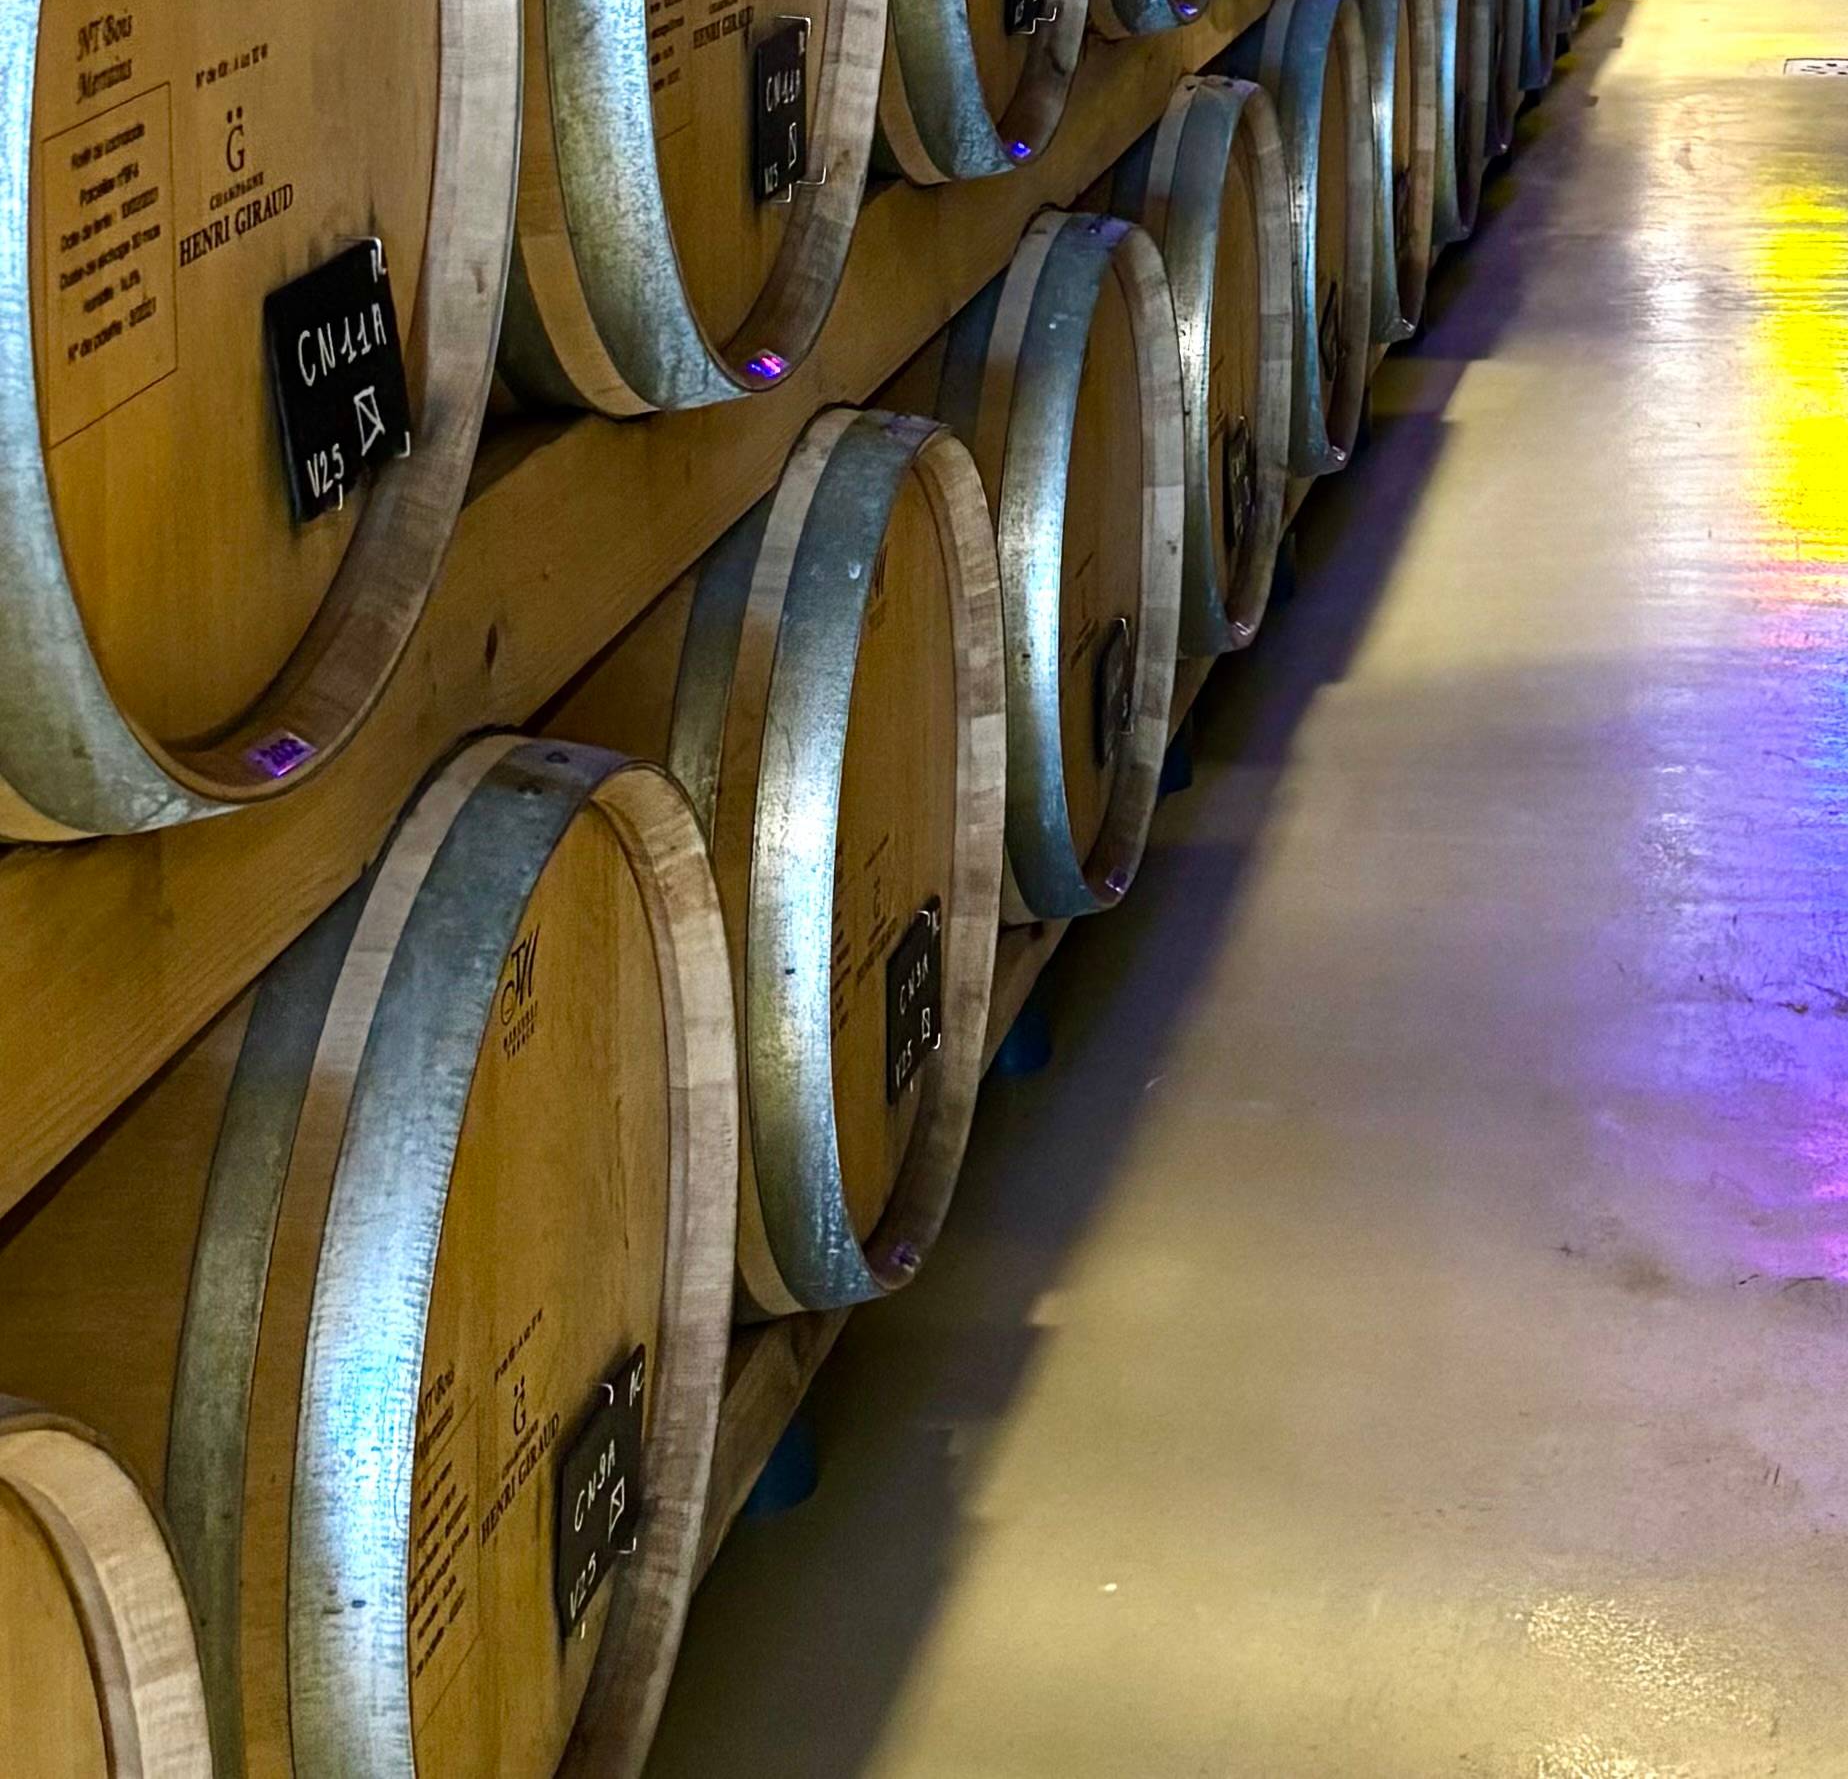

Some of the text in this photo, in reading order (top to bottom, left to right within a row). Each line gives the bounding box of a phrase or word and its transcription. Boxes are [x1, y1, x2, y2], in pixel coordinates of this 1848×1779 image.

[179, 184, 293, 268] HENRI GIRAUD
[298, 302, 387, 387] CN11A
[307, 442, 345, 499] V25
[481, 1474, 517, 1548] HENRI
[518, 1411, 561, 1487] GIRAUD
